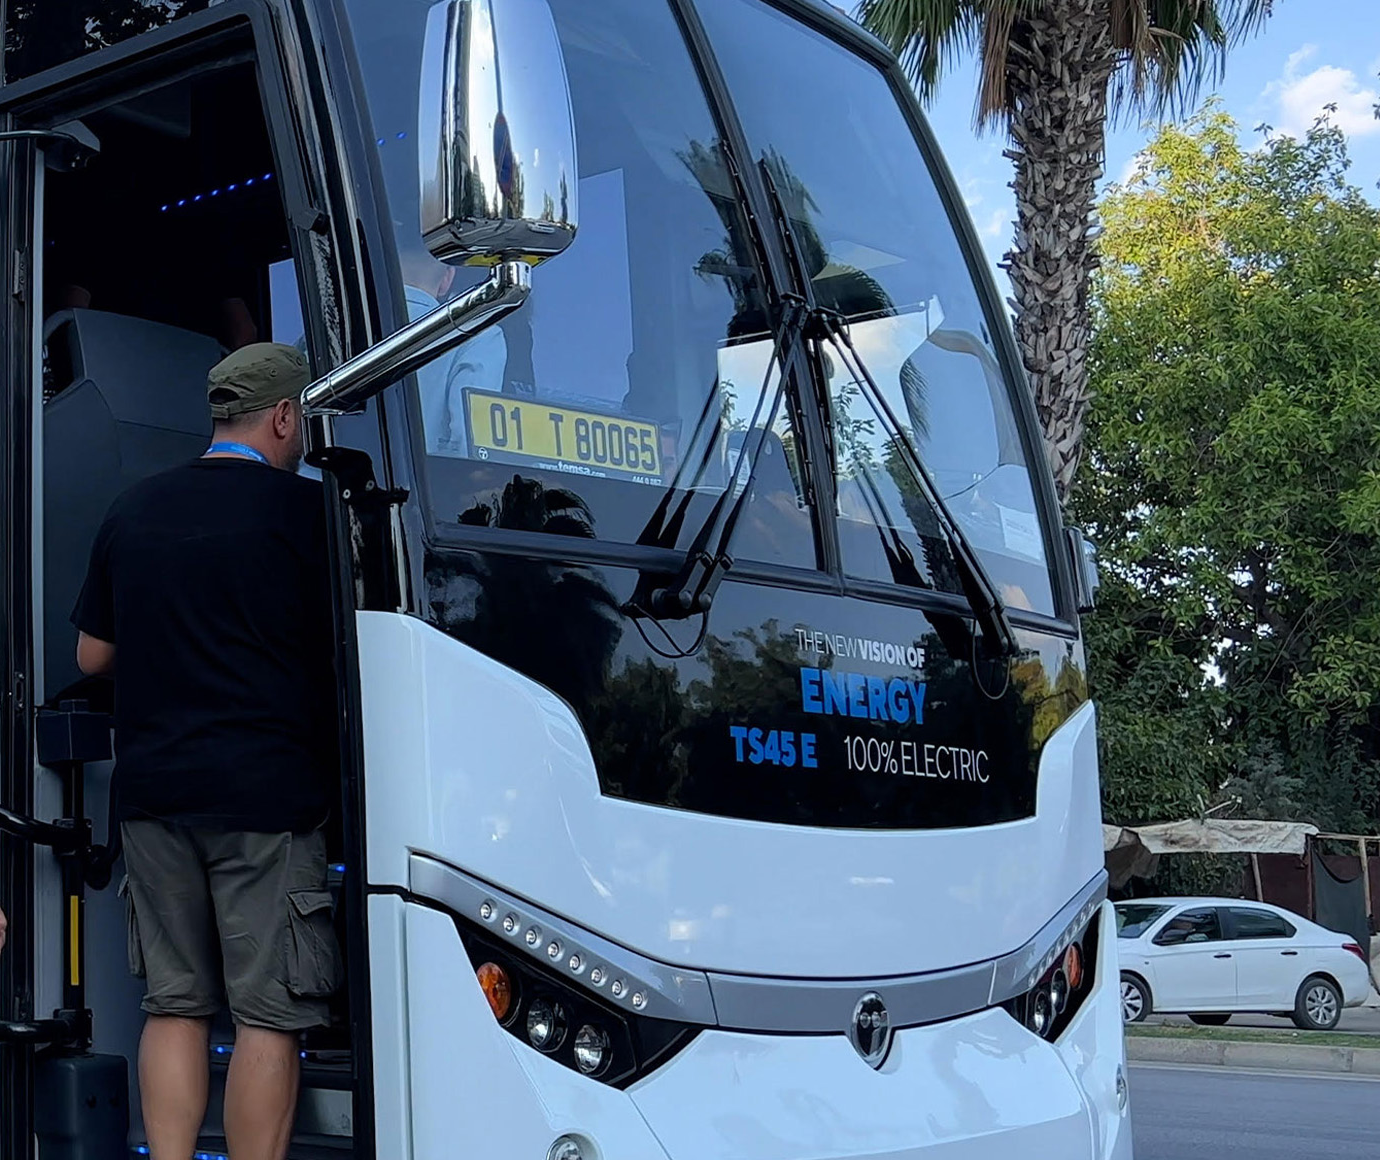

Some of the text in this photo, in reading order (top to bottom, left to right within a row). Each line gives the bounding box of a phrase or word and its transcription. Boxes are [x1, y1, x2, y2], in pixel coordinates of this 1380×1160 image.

[490, 402, 656, 471] 01 T 80065
[794, 628, 925, 668] THE NEW VISION OF
[799, 666, 927, 725] ENERGY
[843, 735, 990, 783] 100% ELECTRIC
